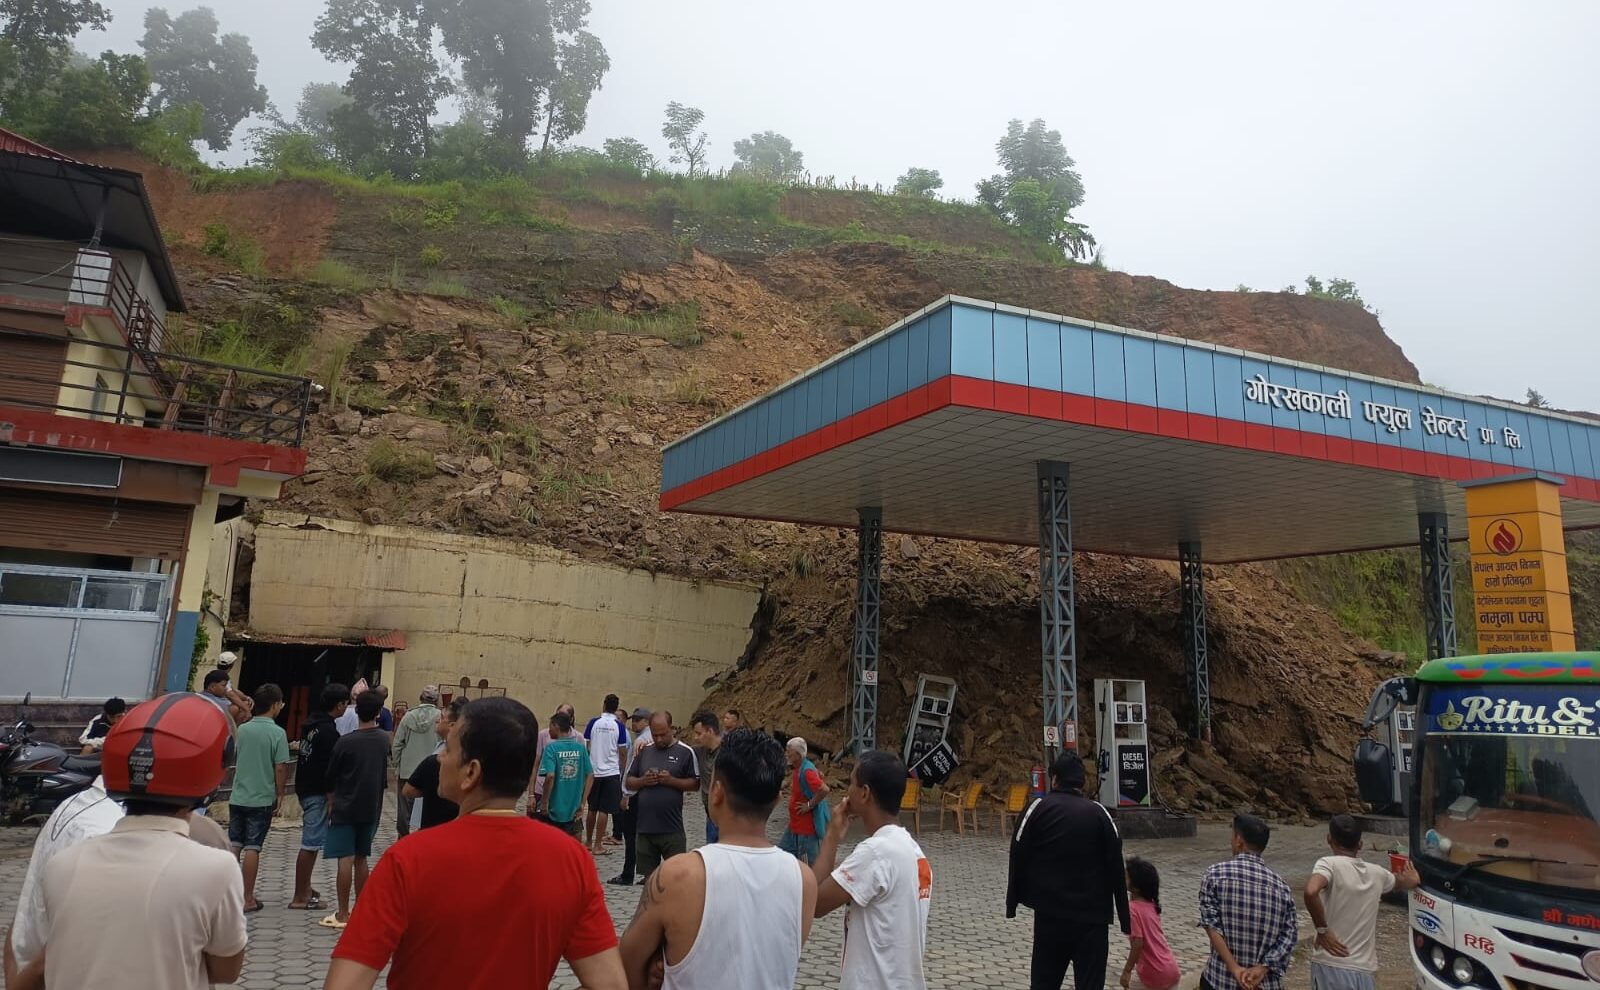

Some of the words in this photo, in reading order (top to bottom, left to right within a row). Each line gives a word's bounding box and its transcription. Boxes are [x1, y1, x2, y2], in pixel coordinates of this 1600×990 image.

[1245, 373, 1352, 419] गोरखकाली
[1421, 405, 1469, 441] सेन्टर
[1480, 612, 1514, 627] नमुना
[1519, 612, 1544, 624] पम्प
[1461, 696, 1550, 725] Ritu
[1552, 697, 1596, 726] &
[1537, 724, 1600, 736] DEL
[557, 750, 580, 758] TOTAL
[1122, 752, 1145, 761] DIESEL
